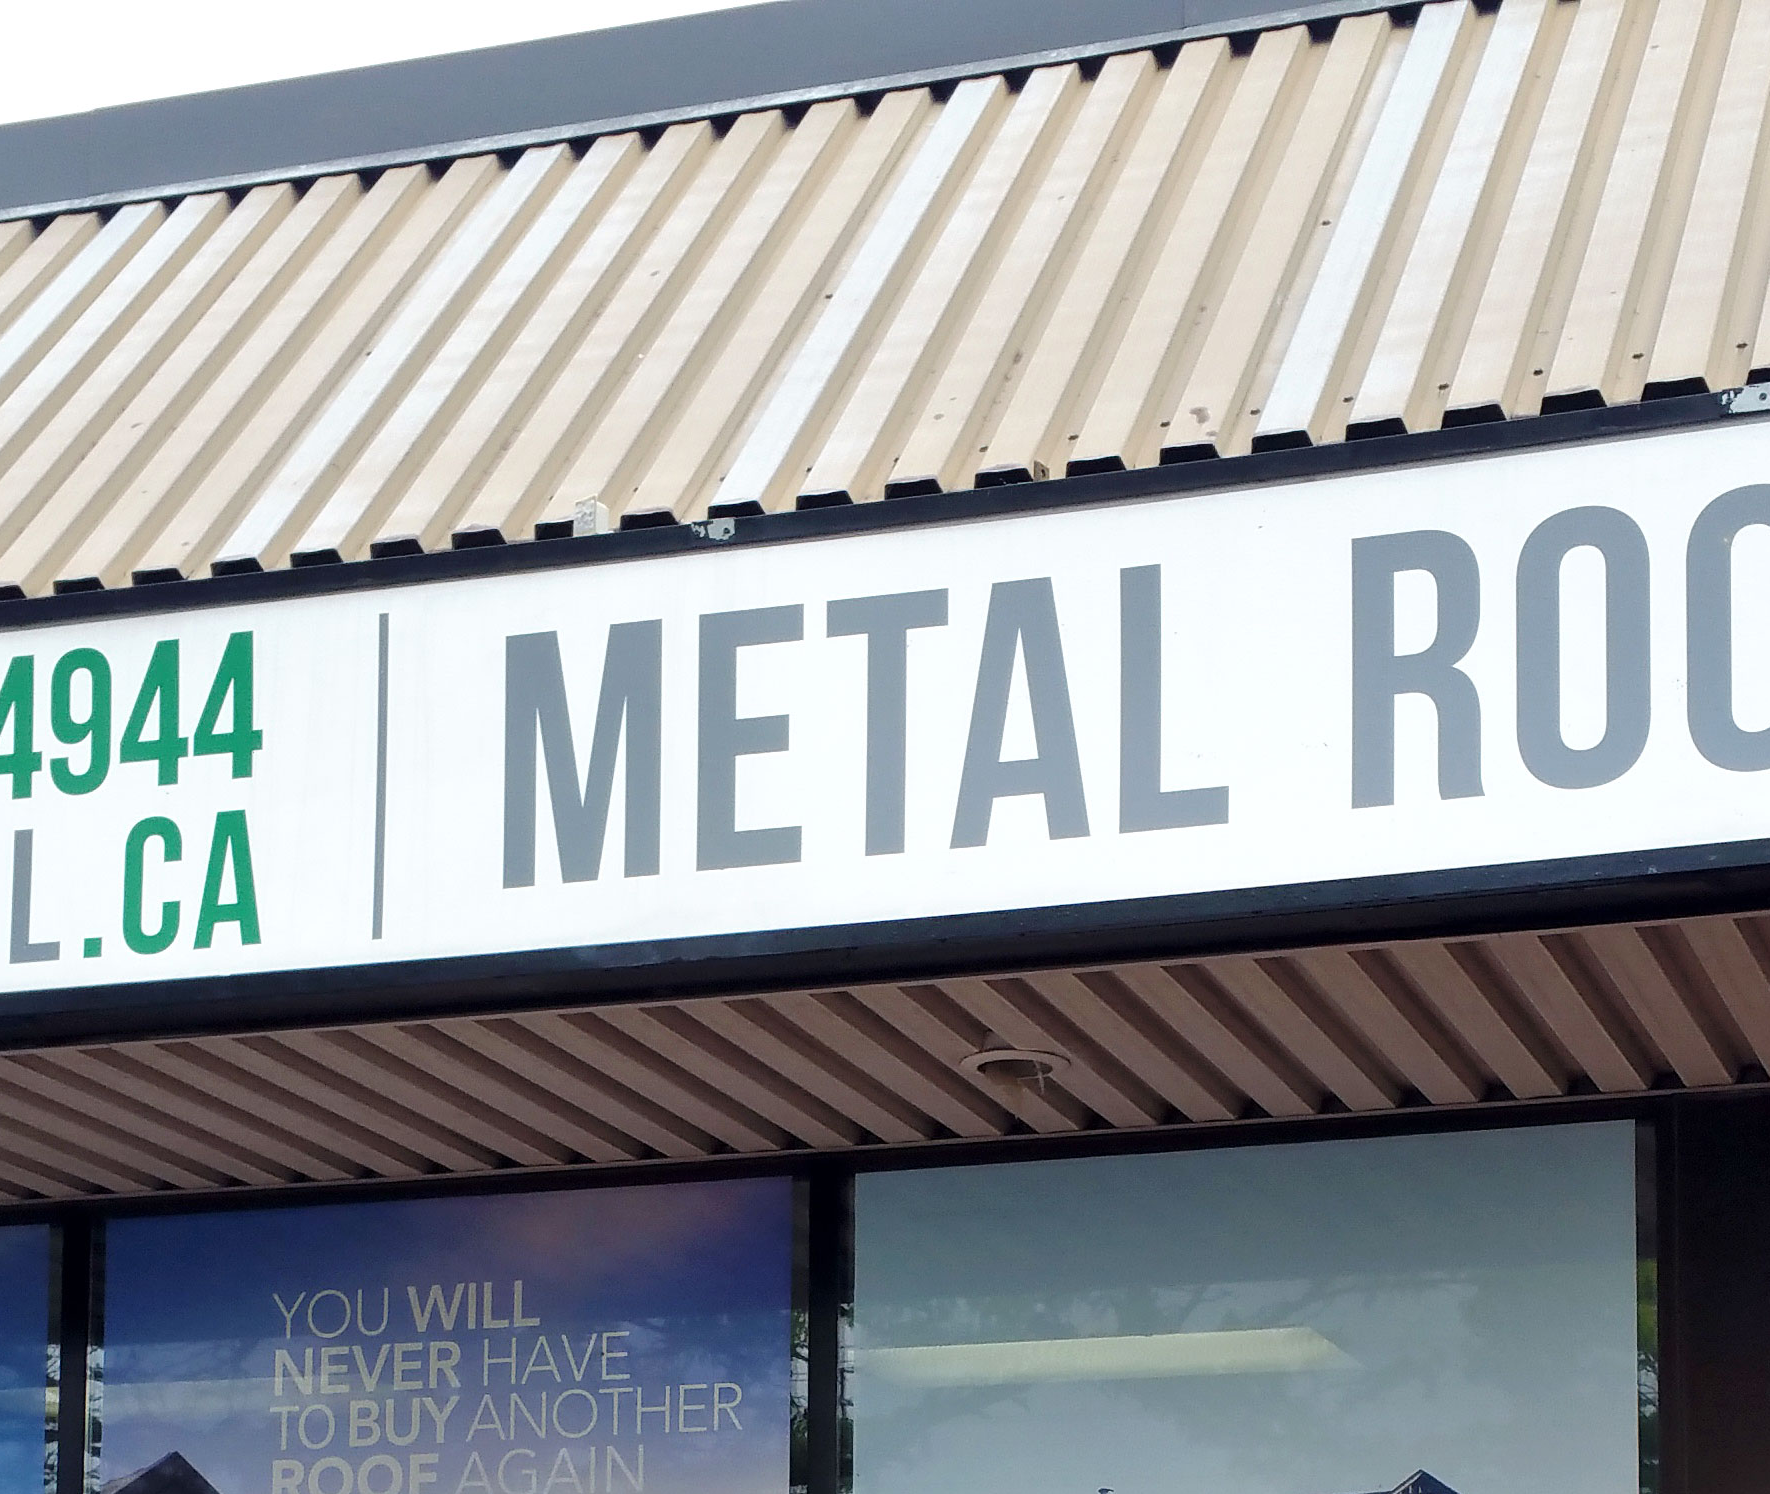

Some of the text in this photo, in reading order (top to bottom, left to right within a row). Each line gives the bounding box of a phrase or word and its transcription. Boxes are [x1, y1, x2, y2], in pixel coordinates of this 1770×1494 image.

[503, 564, 1229, 889] METAL
[272, 1280, 541, 1339] YOU WILL
[273, 1331, 631, 1397] NEVER HAVE
[270, 1382, 743, 1450] TO BUY ANOTHER
